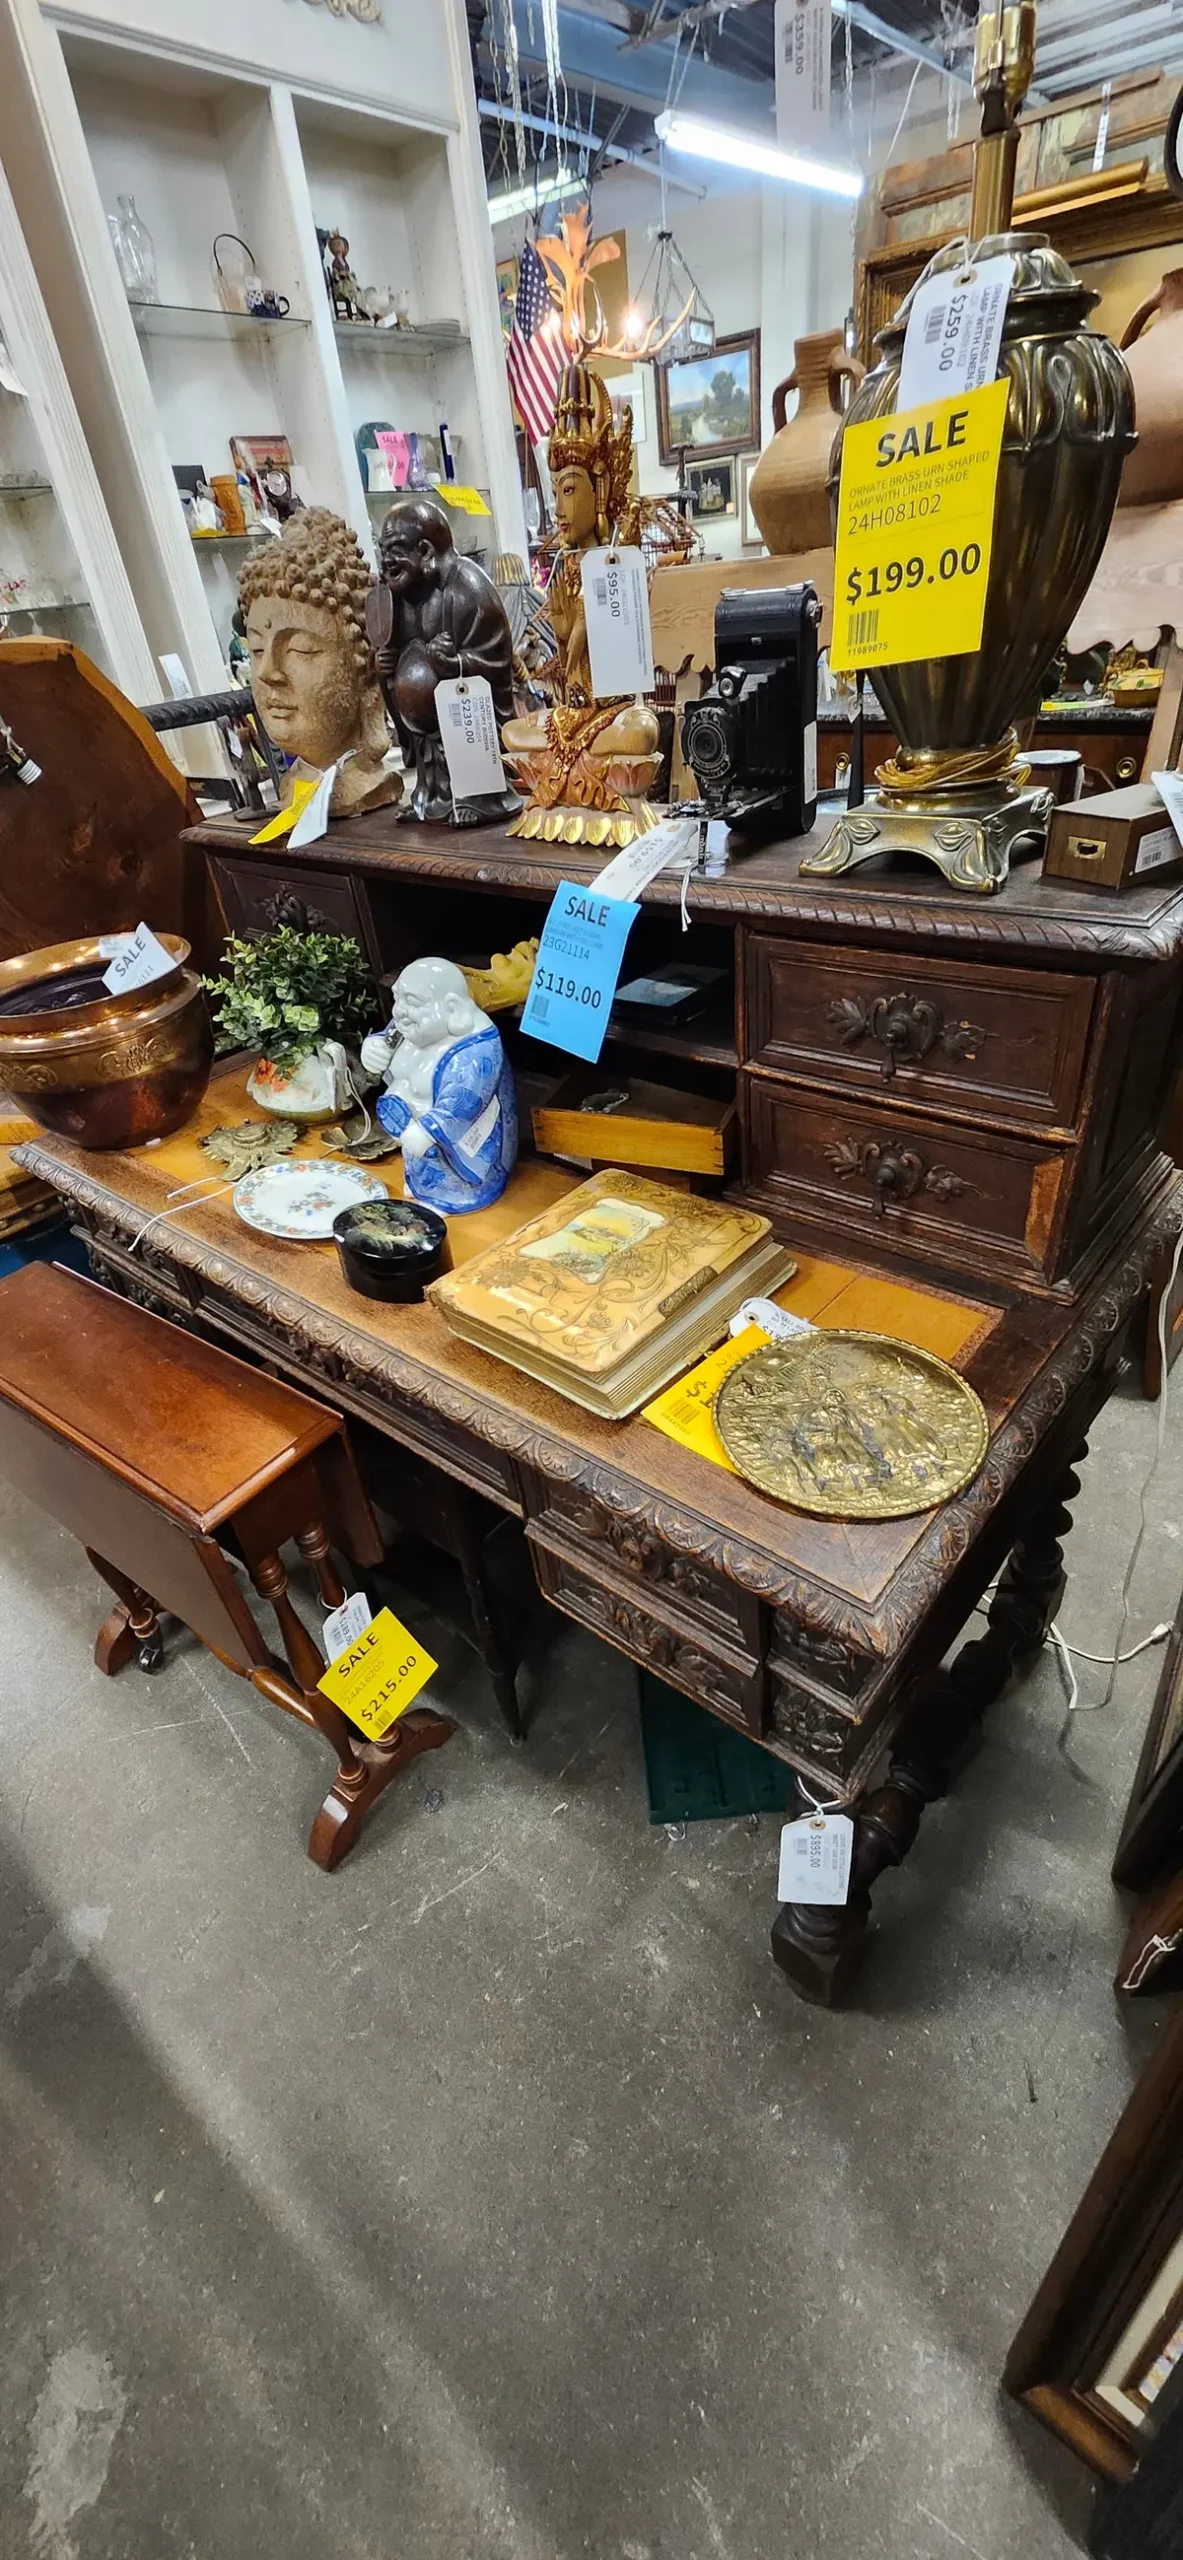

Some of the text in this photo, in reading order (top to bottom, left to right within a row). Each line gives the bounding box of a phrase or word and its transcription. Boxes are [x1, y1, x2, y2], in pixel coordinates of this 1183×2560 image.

[939, 294, 968, 371] $259.00
[973, 316, 985, 344] WITH
[980, 326, 993, 364] BRASS
[966, 347, 979, 380] LINEN
[382, 435, 398, 444] SALE
[876, 410, 969, 468] SALE
[848, 470, 969, 512] LAMP WITH LINEN SHADE
[849, 450, 990, 498] ORNATE BRASS URN SHAPED
[847, 493, 941, 537] 24H08102
[607, 571, 621, 618] $95.00
[846, 543, 981, 606] $199.00
[848, 642, 889, 657] 11989075
[461, 698, 475, 744] $239.00
[564, 896, 611, 927] SALE
[114, 936, 146, 977] SALE
[542, 934, 591, 960] 23G21114
[535, 966, 602, 1009] $119.00
[338, 1632, 379, 1678] SALE
[361, 1655, 417, 1722] $215.00
[810, 1835, 822, 1868] $895.00
